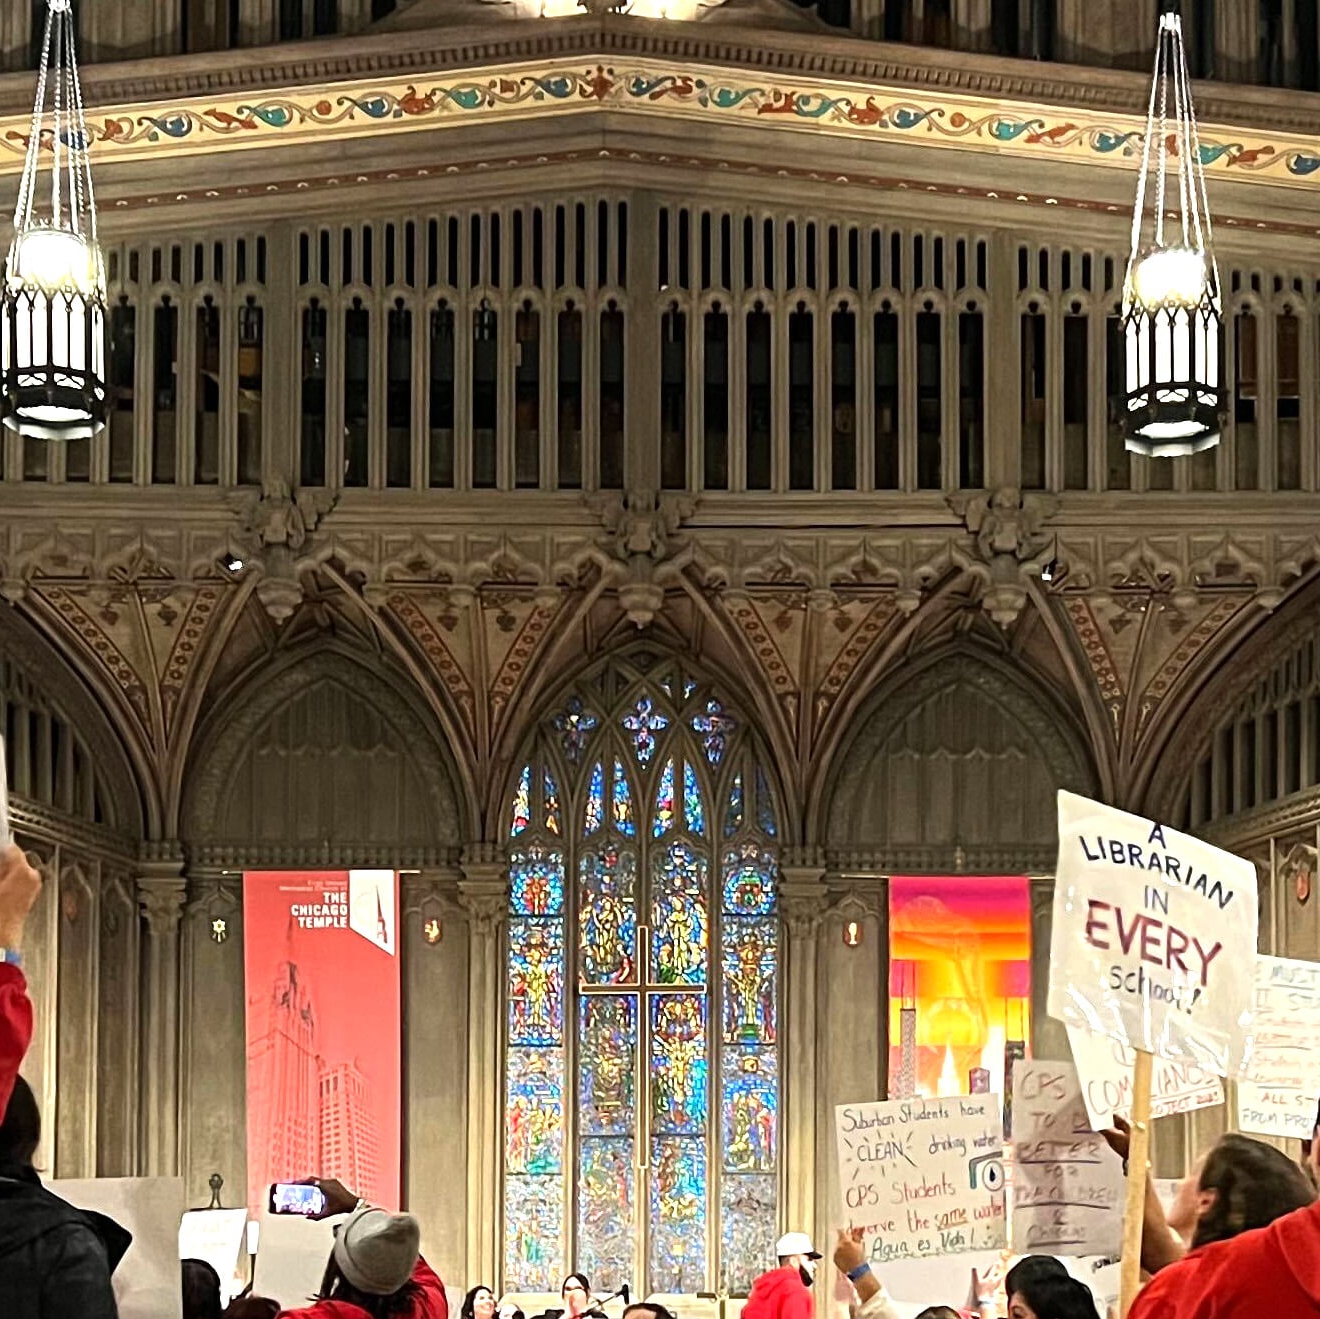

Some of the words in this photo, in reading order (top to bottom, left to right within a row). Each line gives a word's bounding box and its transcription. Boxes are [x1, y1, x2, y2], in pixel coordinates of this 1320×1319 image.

[1148, 822, 1166, 849] A
[1078, 835, 1234, 910] LIBRARIAN
[291, 904, 348, 916] CHICAGO
[323, 892, 347, 903] THE
[1144, 885, 1169, 915] IN
[298, 917, 347, 929] TEMPLE
[1085, 899, 1223, 987] EVERY
[842, 1108, 895, 1132] Suburban
[899, 1103, 949, 1123] Students
[960, 1101, 985, 1116] have
[857, 1141, 905, 1162] CLEAN
[846, 1184, 879, 1208] CPS
[890, 1172, 956, 1204] Students
[907, 1209, 930, 1233] the
[936, 1207, 968, 1227] same
